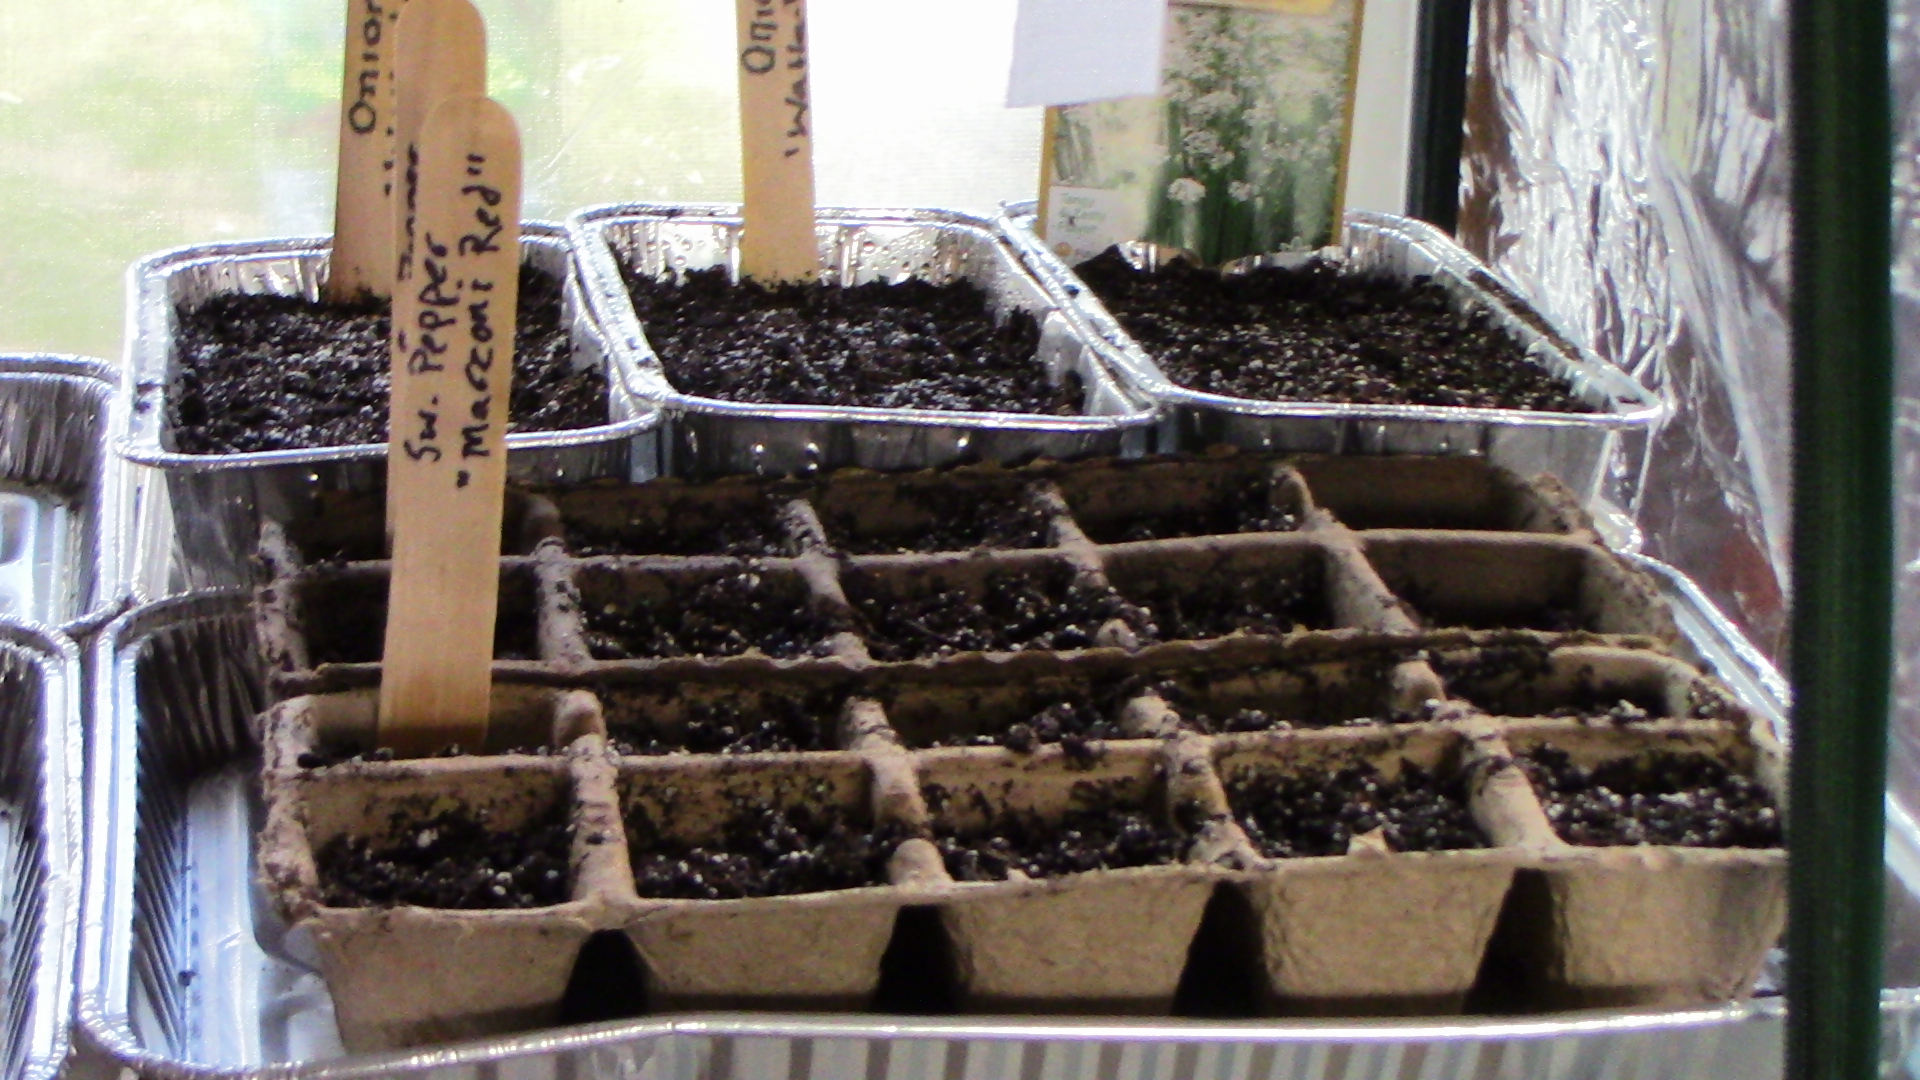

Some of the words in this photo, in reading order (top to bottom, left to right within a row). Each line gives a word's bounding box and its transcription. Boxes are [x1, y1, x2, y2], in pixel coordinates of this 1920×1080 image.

[741, 0, 777, 74] Oni
[408, 231, 460, 376] Pepper
[404, 397, 442, 461] Sw.
